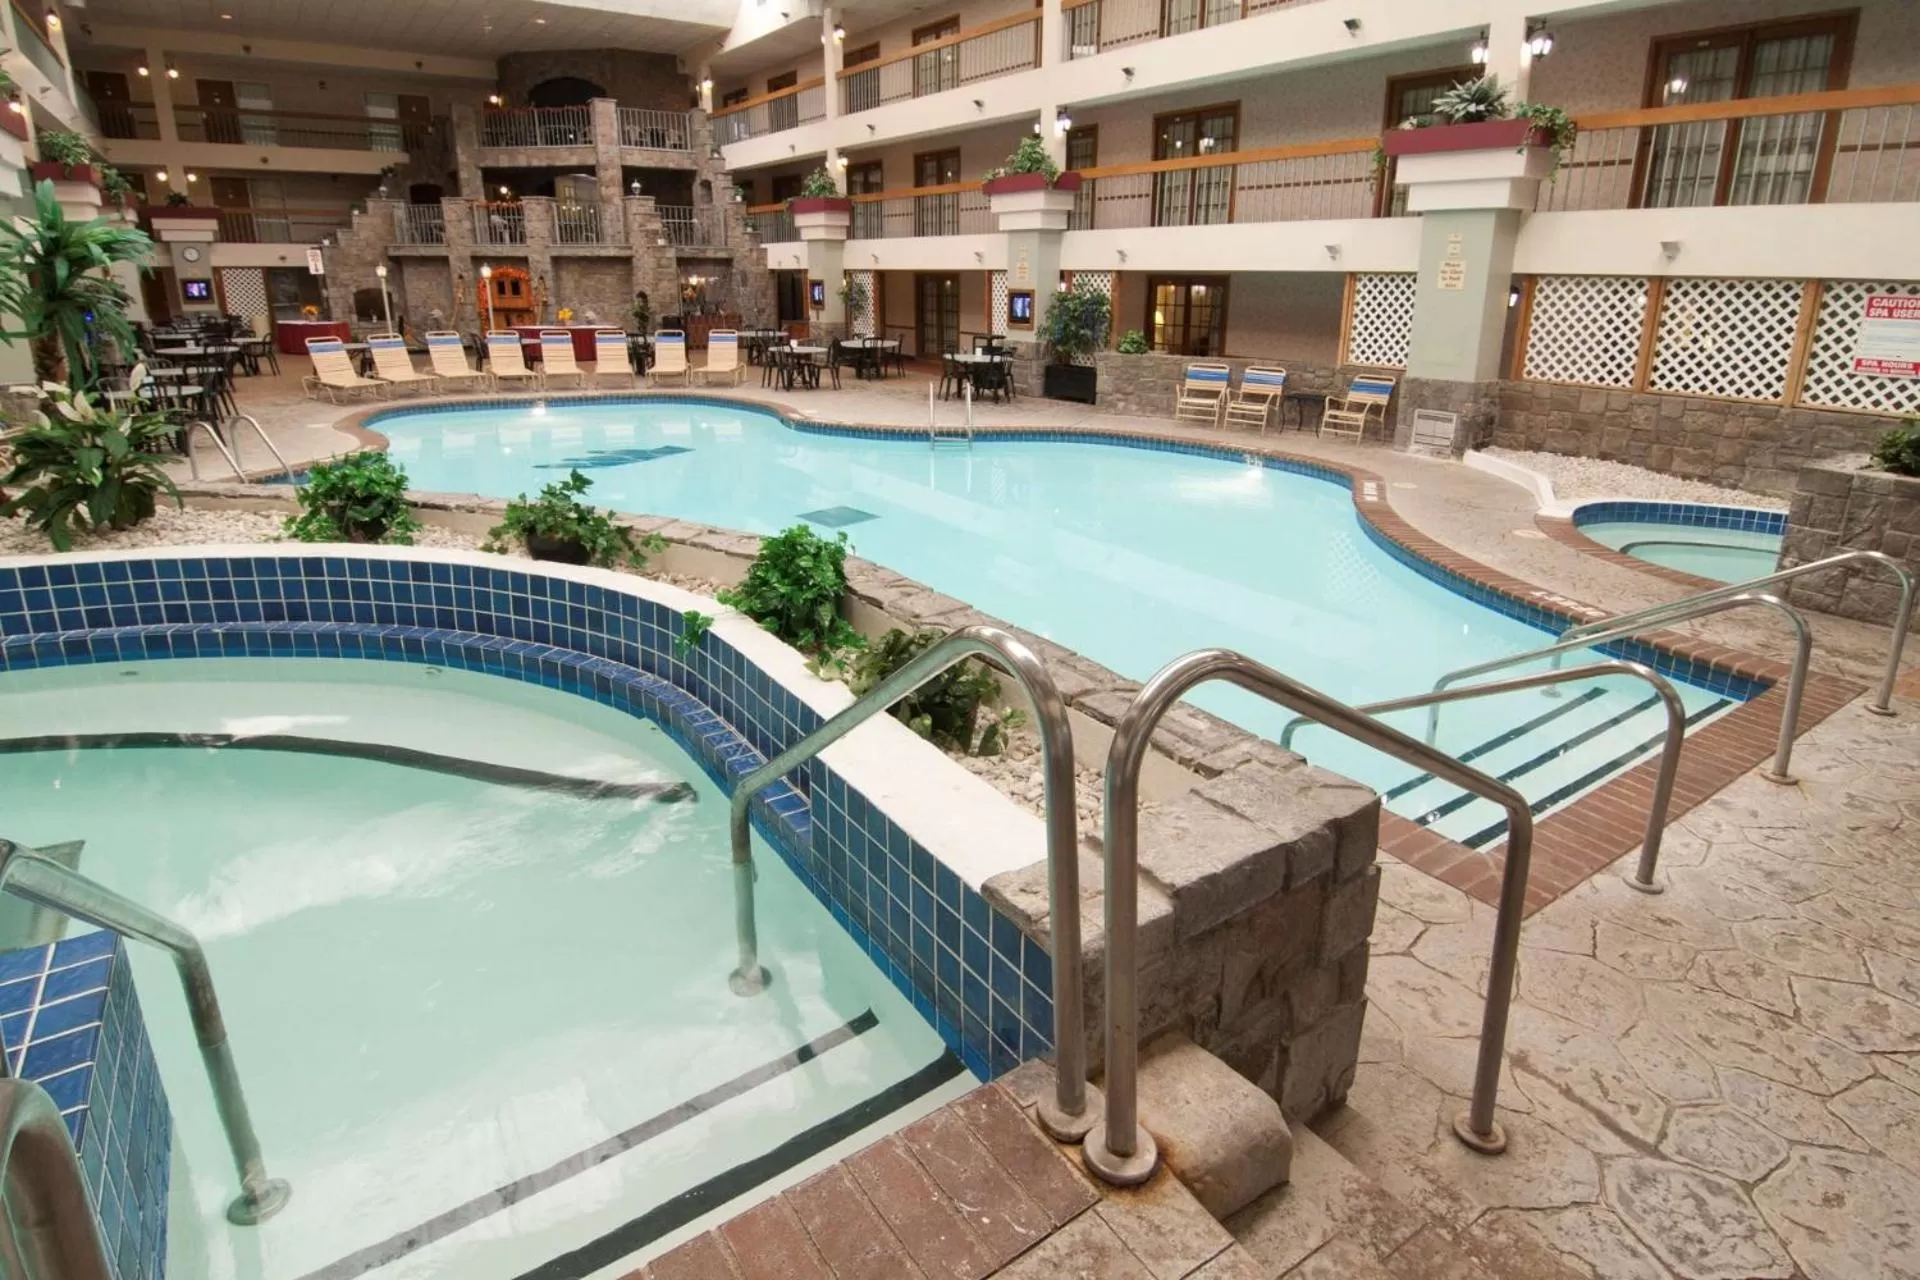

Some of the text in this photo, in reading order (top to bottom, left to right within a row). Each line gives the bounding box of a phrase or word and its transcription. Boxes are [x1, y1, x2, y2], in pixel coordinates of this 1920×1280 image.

[1869, 307, 1889, 317] SPA
[1861, 359, 1914, 369] SPA HOURS
